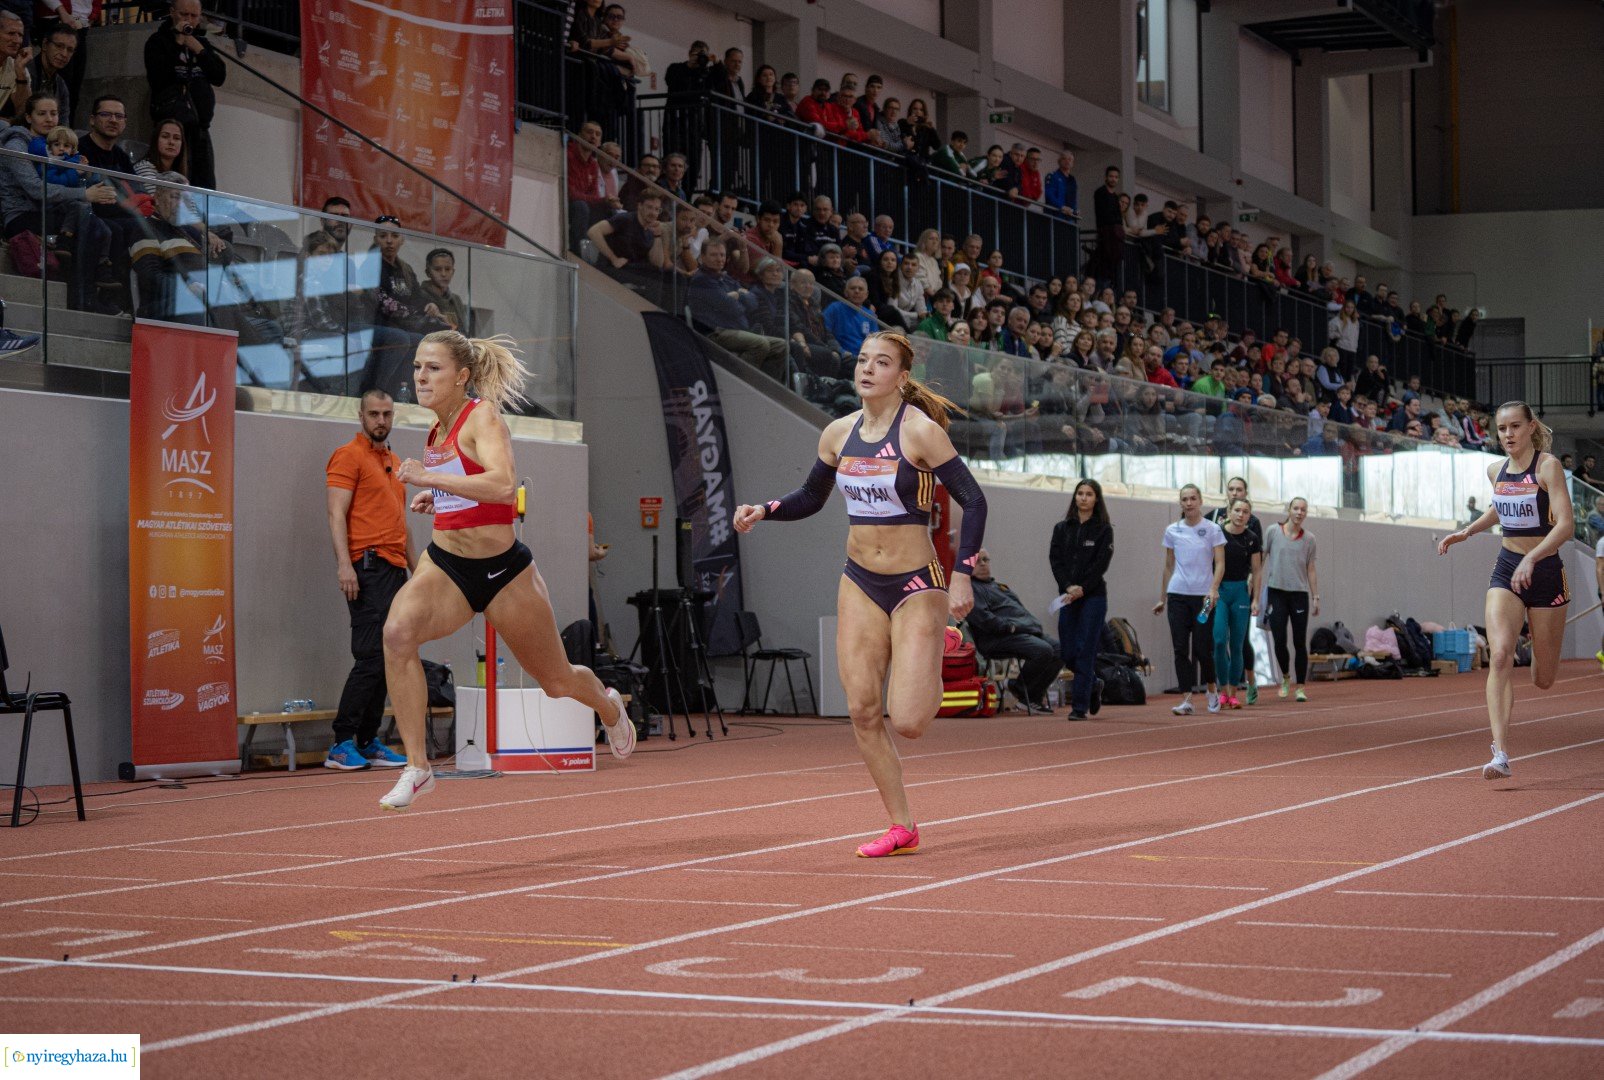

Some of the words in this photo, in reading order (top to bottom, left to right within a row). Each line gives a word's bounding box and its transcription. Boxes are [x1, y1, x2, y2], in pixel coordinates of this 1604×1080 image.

[475, 8, 505, 18] ATLETIKA
[162, 448, 212, 475] MASZ
[137, 520, 165, 529] MAGYAR
[165, 519, 197, 530] ATLÉTIKAI
[147, 641, 180, 659] ATLETIKA
[203, 645, 224, 655] MASZ
[197, 692, 230, 713] VAGYOK
